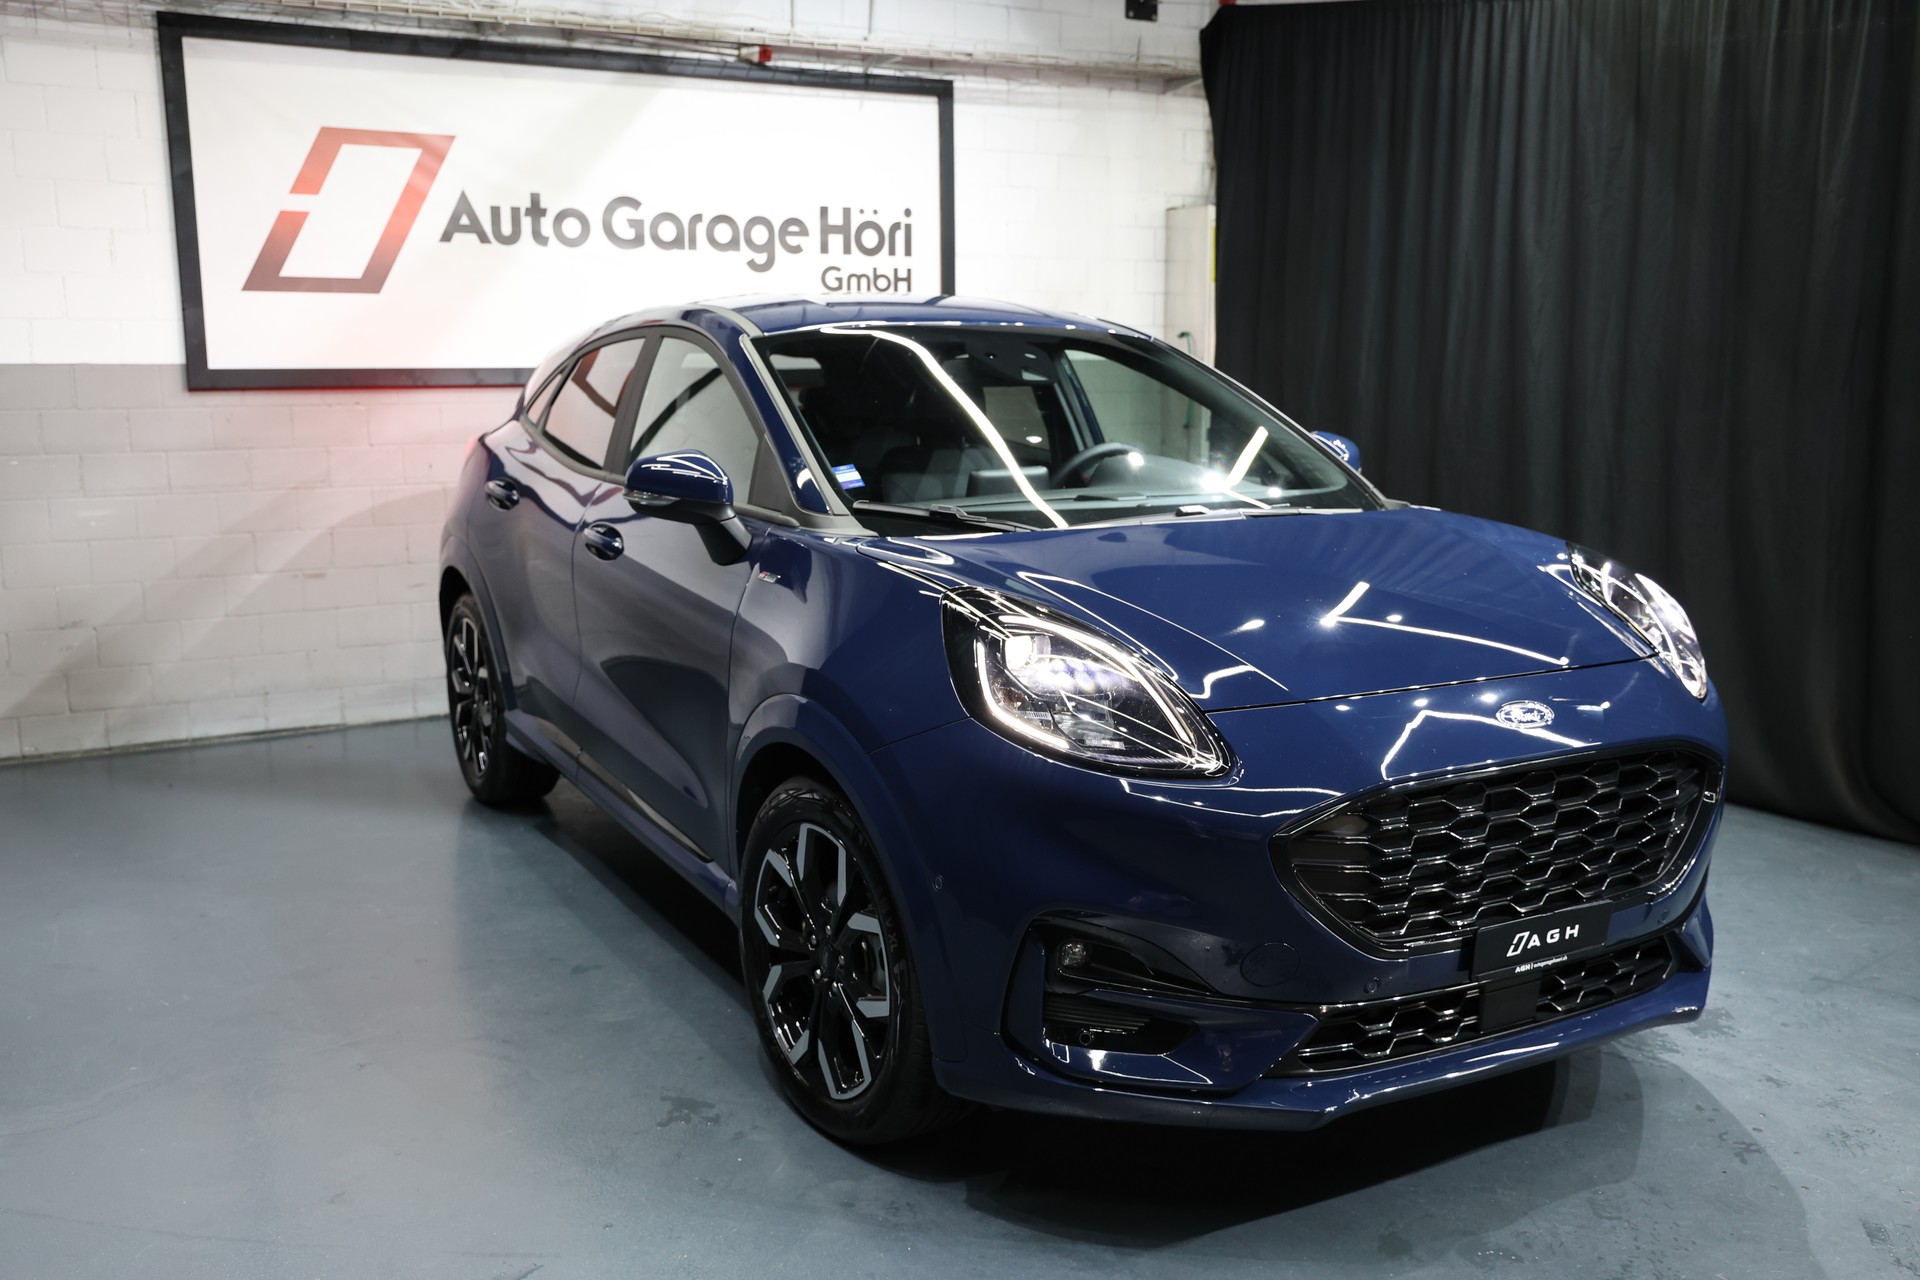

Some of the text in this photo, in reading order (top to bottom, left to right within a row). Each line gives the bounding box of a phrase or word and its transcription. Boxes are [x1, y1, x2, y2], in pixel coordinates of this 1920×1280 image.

[439, 190, 912, 272] Auto Garage Höri
[820, 265, 912, 292] GmbH
